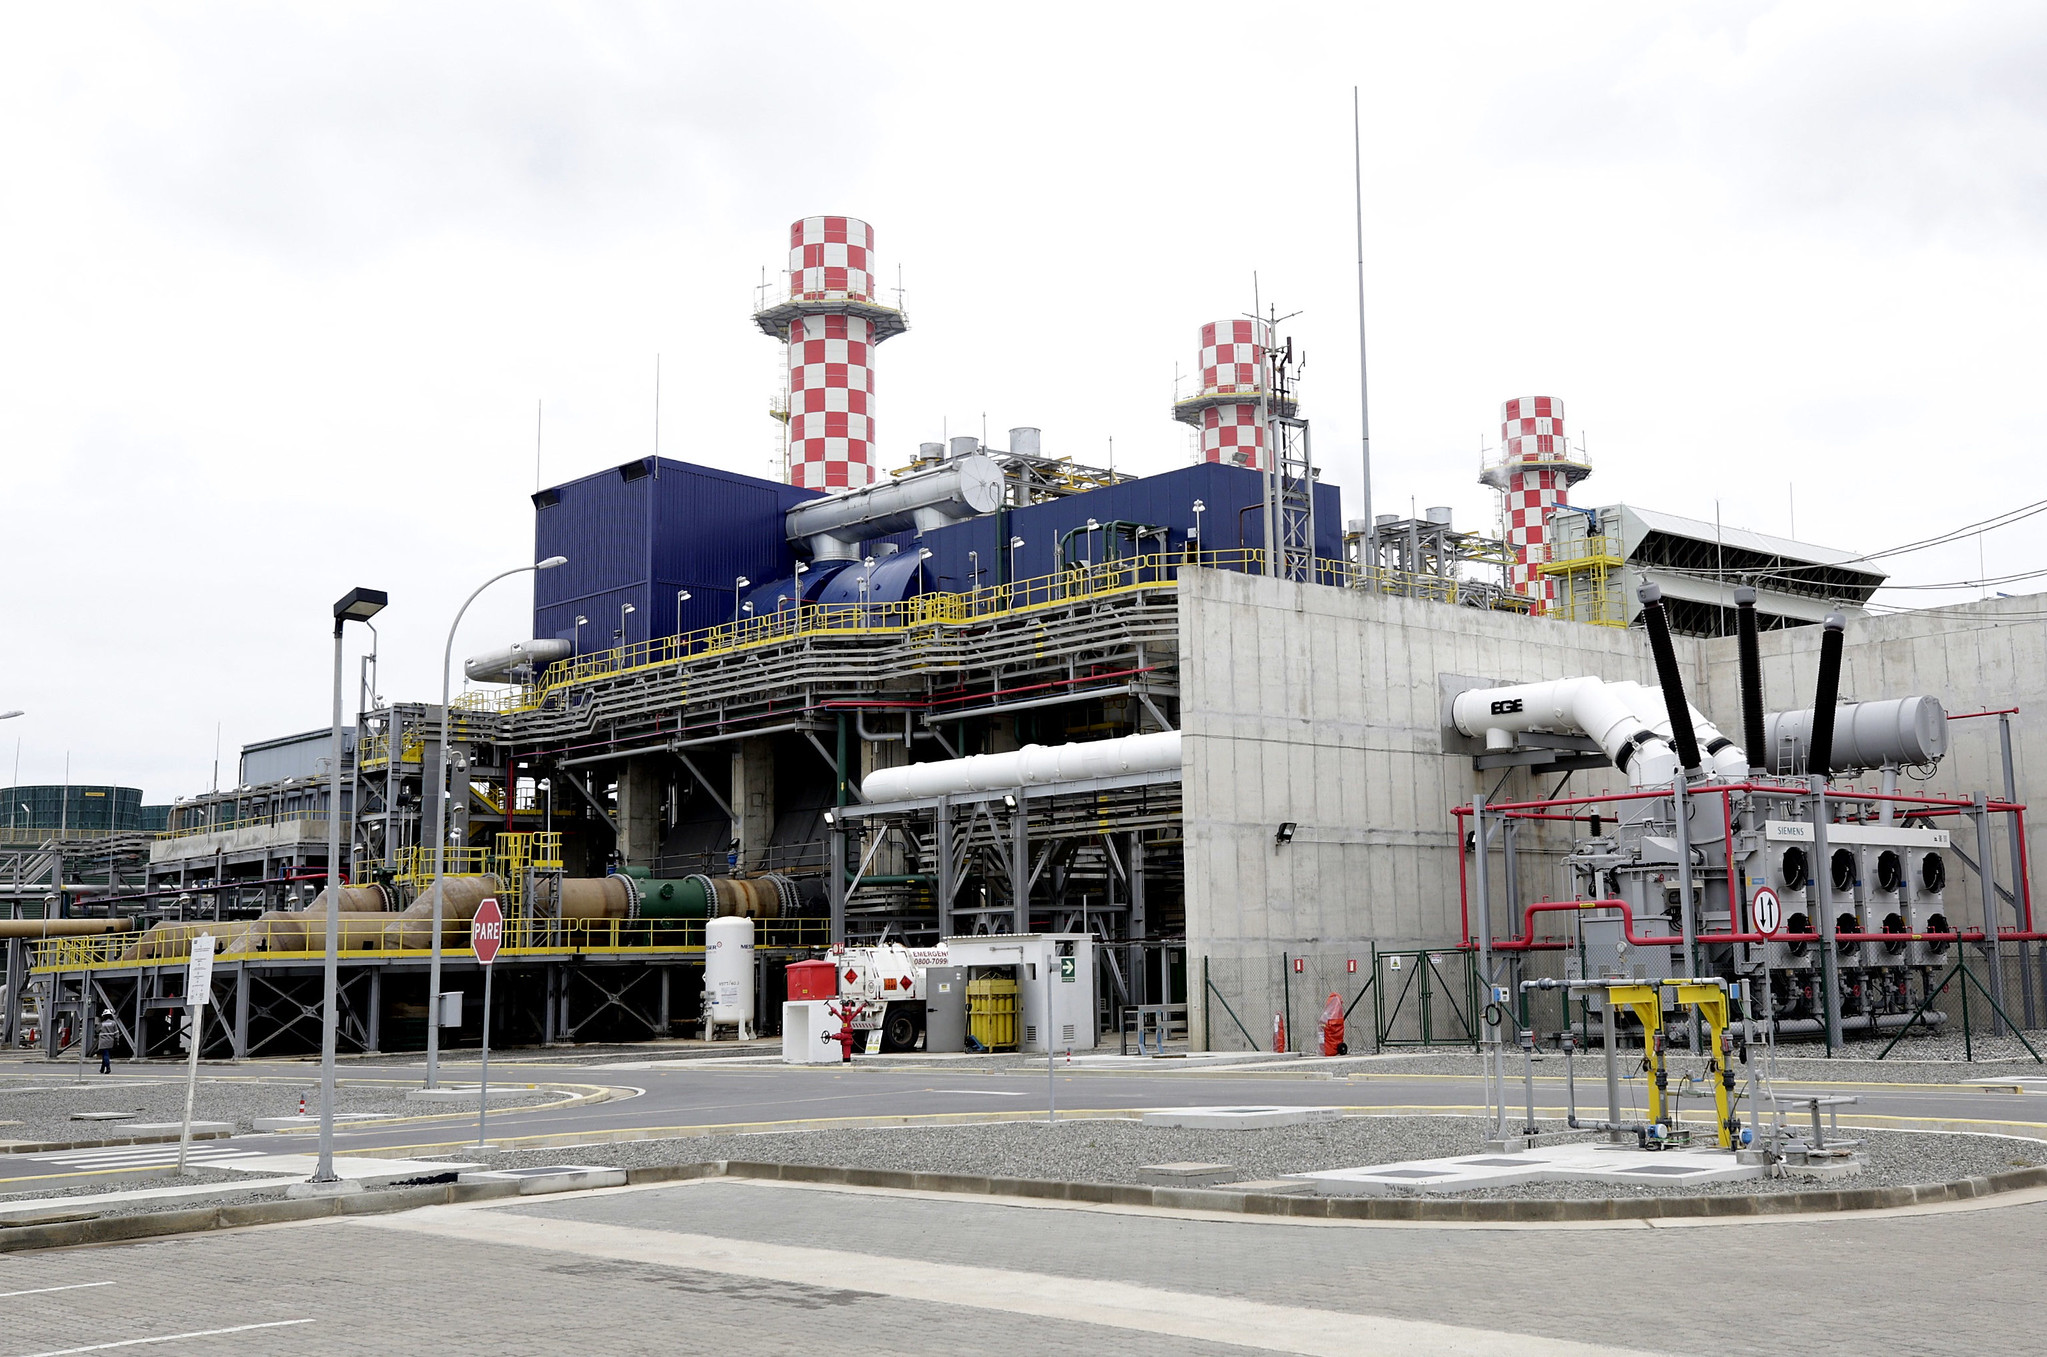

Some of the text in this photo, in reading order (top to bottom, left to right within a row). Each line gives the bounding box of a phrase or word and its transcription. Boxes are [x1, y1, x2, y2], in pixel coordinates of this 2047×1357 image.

[1491, 698, 1523, 715] EGE
[1777, 826, 1804, 836] SIEMENS
[474, 922, 500, 940] PARE
